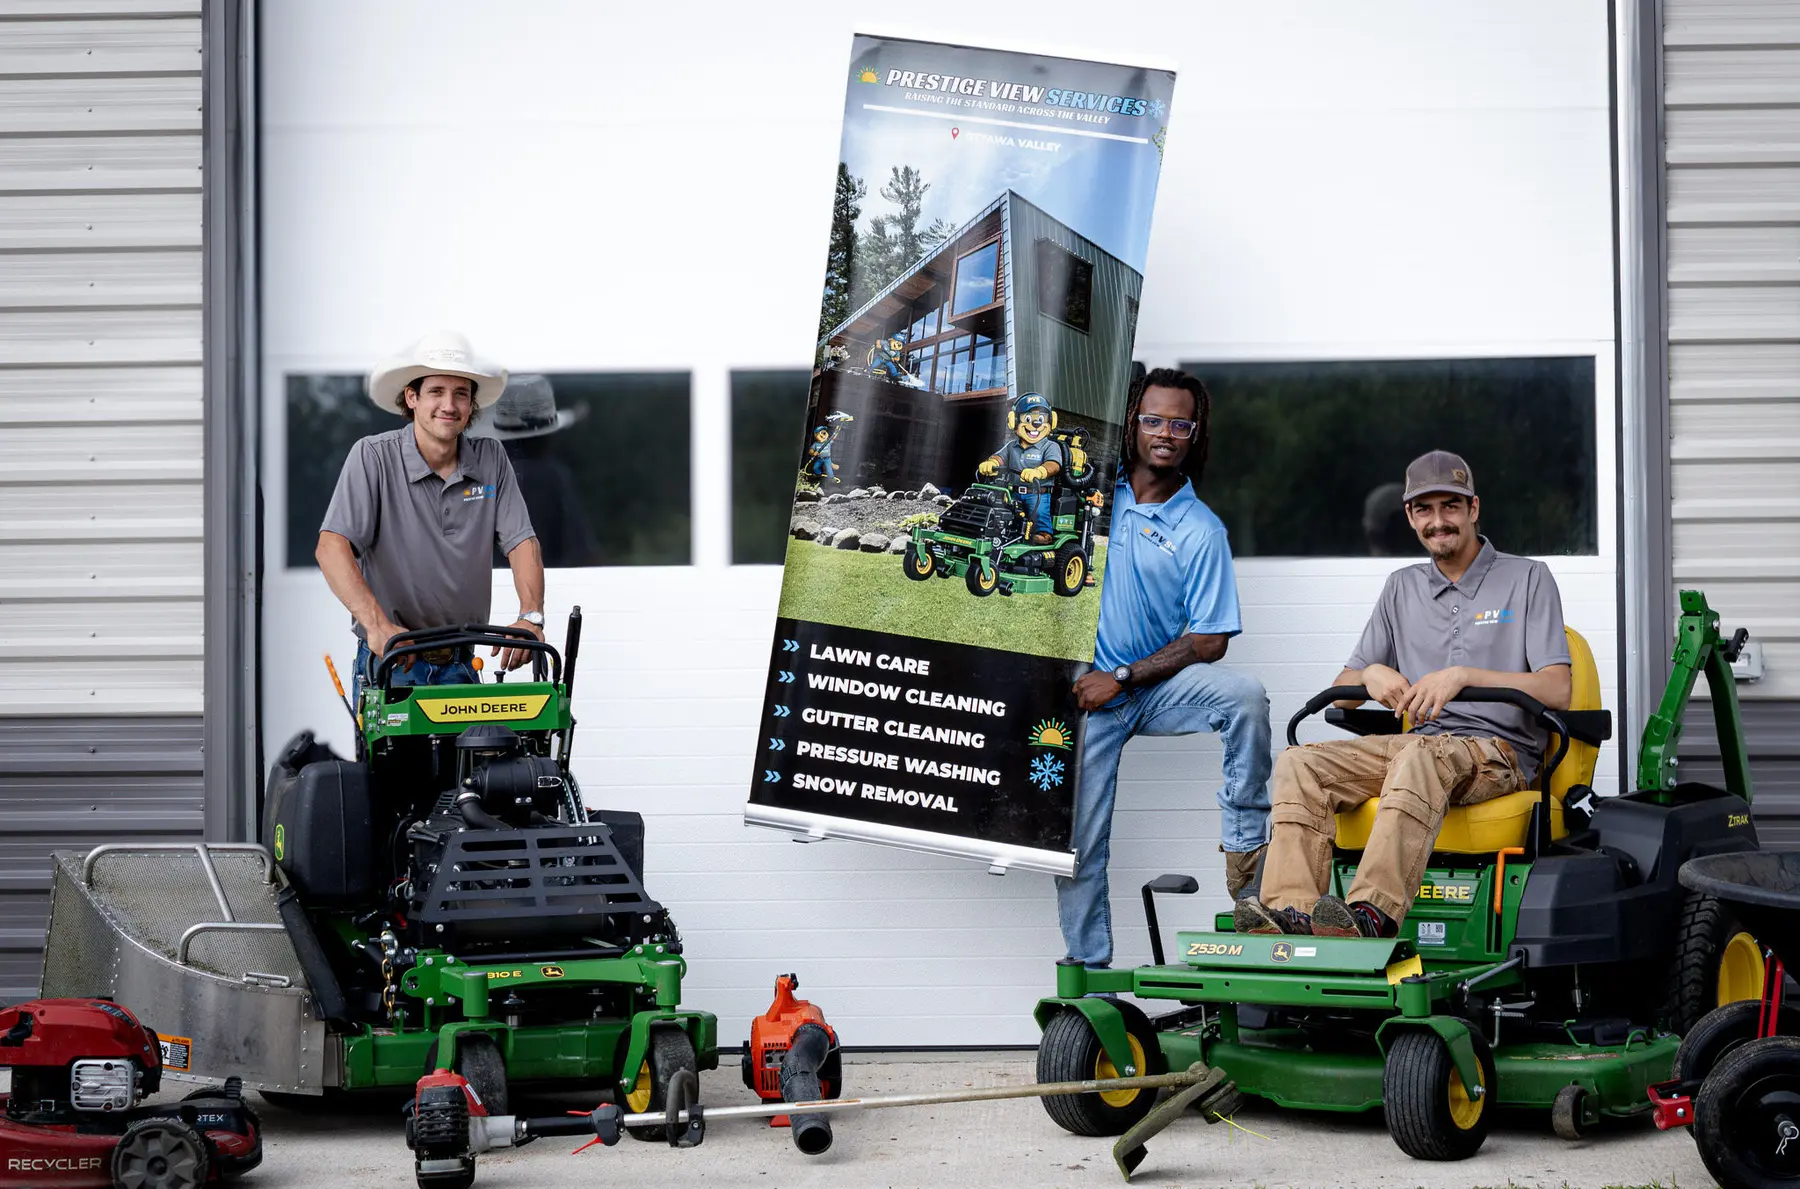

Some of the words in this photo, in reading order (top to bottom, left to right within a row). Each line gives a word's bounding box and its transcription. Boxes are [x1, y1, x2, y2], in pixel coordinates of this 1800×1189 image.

[885, 68, 987, 97] PRESTIGE
[989, 81, 1045, 103] VIEW
[1045, 88, 1148, 117] SERVICES
[904, 91, 944, 104] RAISING
[946, 96, 963, 106] THE
[964, 99, 1016, 113] STANDARD
[1017, 106, 1055, 118] ACROSS
[1057, 110, 1075, 121] THE
[1076, 113, 1111, 124] VALLEY
[1017, 138, 1062, 153] VALLEY
[810, 643, 871, 667] LAWN
[876, 654, 931, 676] CARE
[807, 673, 901, 701] WINDOW
[905, 688, 1006, 717] CLEANING
[441, 704, 478, 715] JOHN
[481, 703, 527, 714] DEERE
[801, 707, 878, 733] GUTTER
[883, 720, 986, 749] CLEANING
[796, 740, 899, 770] PRESSURE
[904, 757, 1000, 786] WASHING
[792, 773, 857, 796] SNOW
[861, 784, 959, 813] REMOVAL
[1415, 885, 1471, 900] EERE
[1187, 943, 1228, 956] Z530
[1228, 945, 1244, 956] M
[512, 970, 522, 978] E
[176, 1113, 224, 1123] VRTEX
[8, 1157, 102, 1171] RECYCLER
